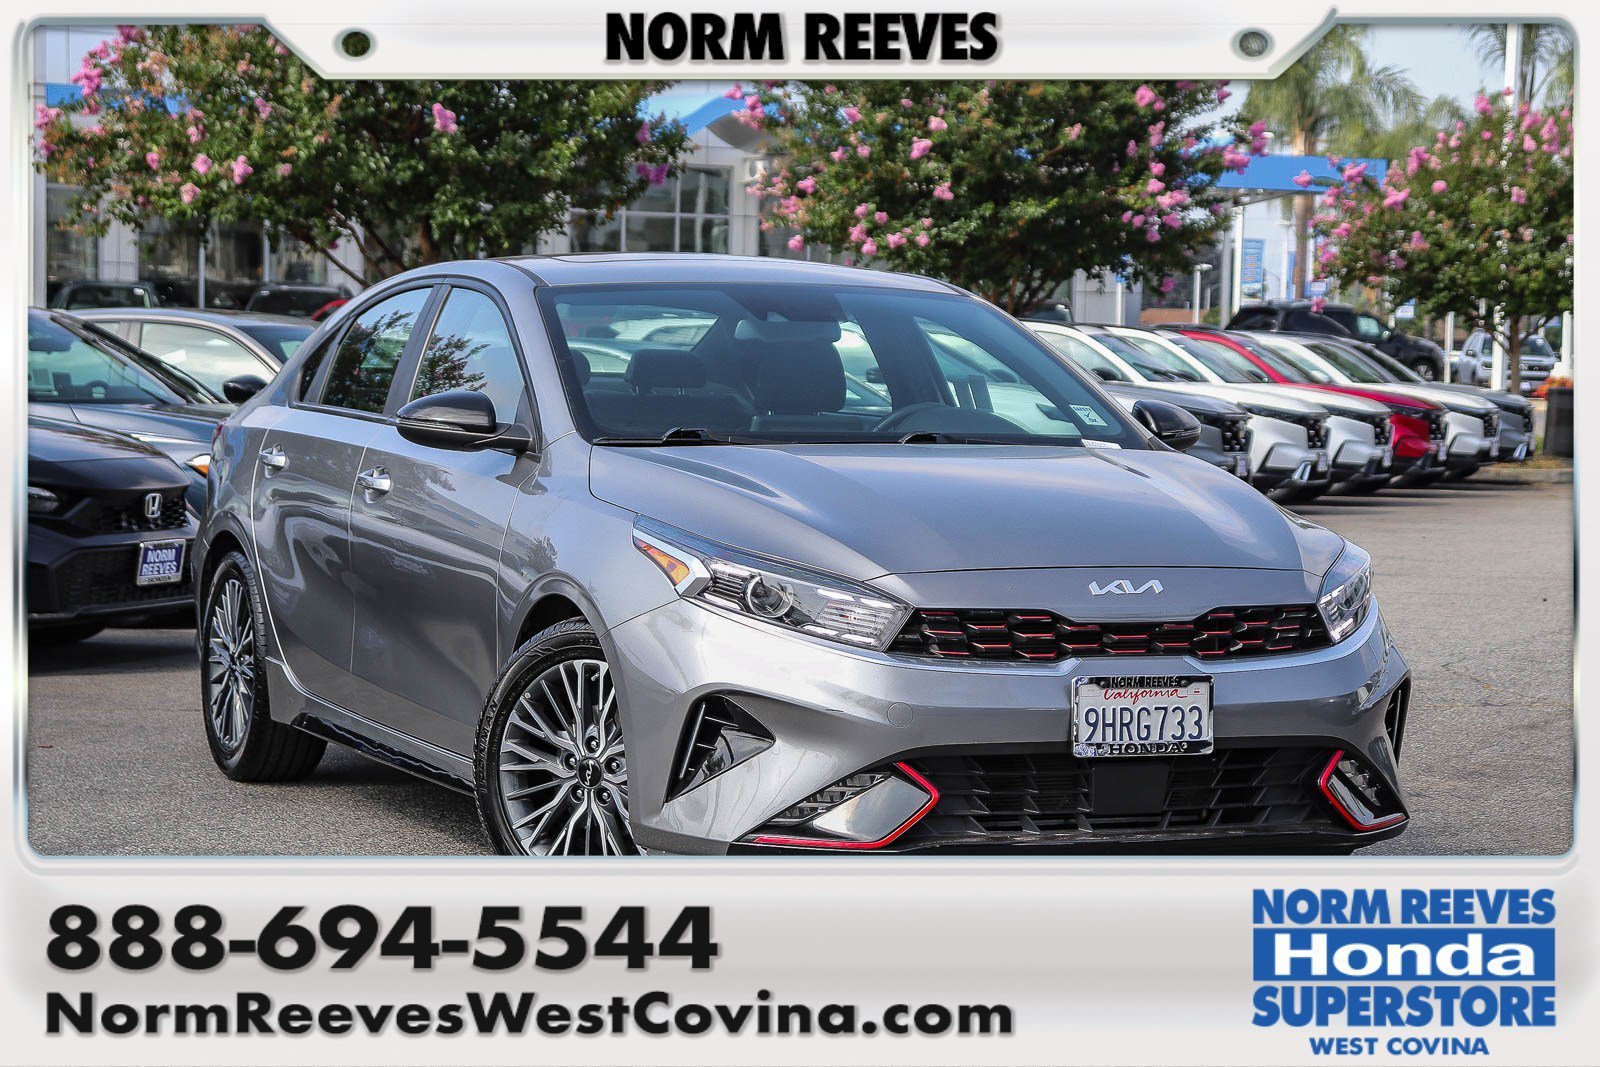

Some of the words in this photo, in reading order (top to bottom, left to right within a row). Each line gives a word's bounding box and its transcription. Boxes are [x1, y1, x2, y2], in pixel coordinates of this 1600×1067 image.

[147, 549, 175, 563] NORM
[141, 561, 177, 576] REEVES
[1089, 579, 1164, 595] KIA
[1111, 676, 1139, 688] NORM
[1145, 675, 1180, 688] REEVES
[1104, 687, 1188, 705] California
[1084, 705, 1203, 742] 9HRG733
[1109, 742, 1184, 754] HONDA
